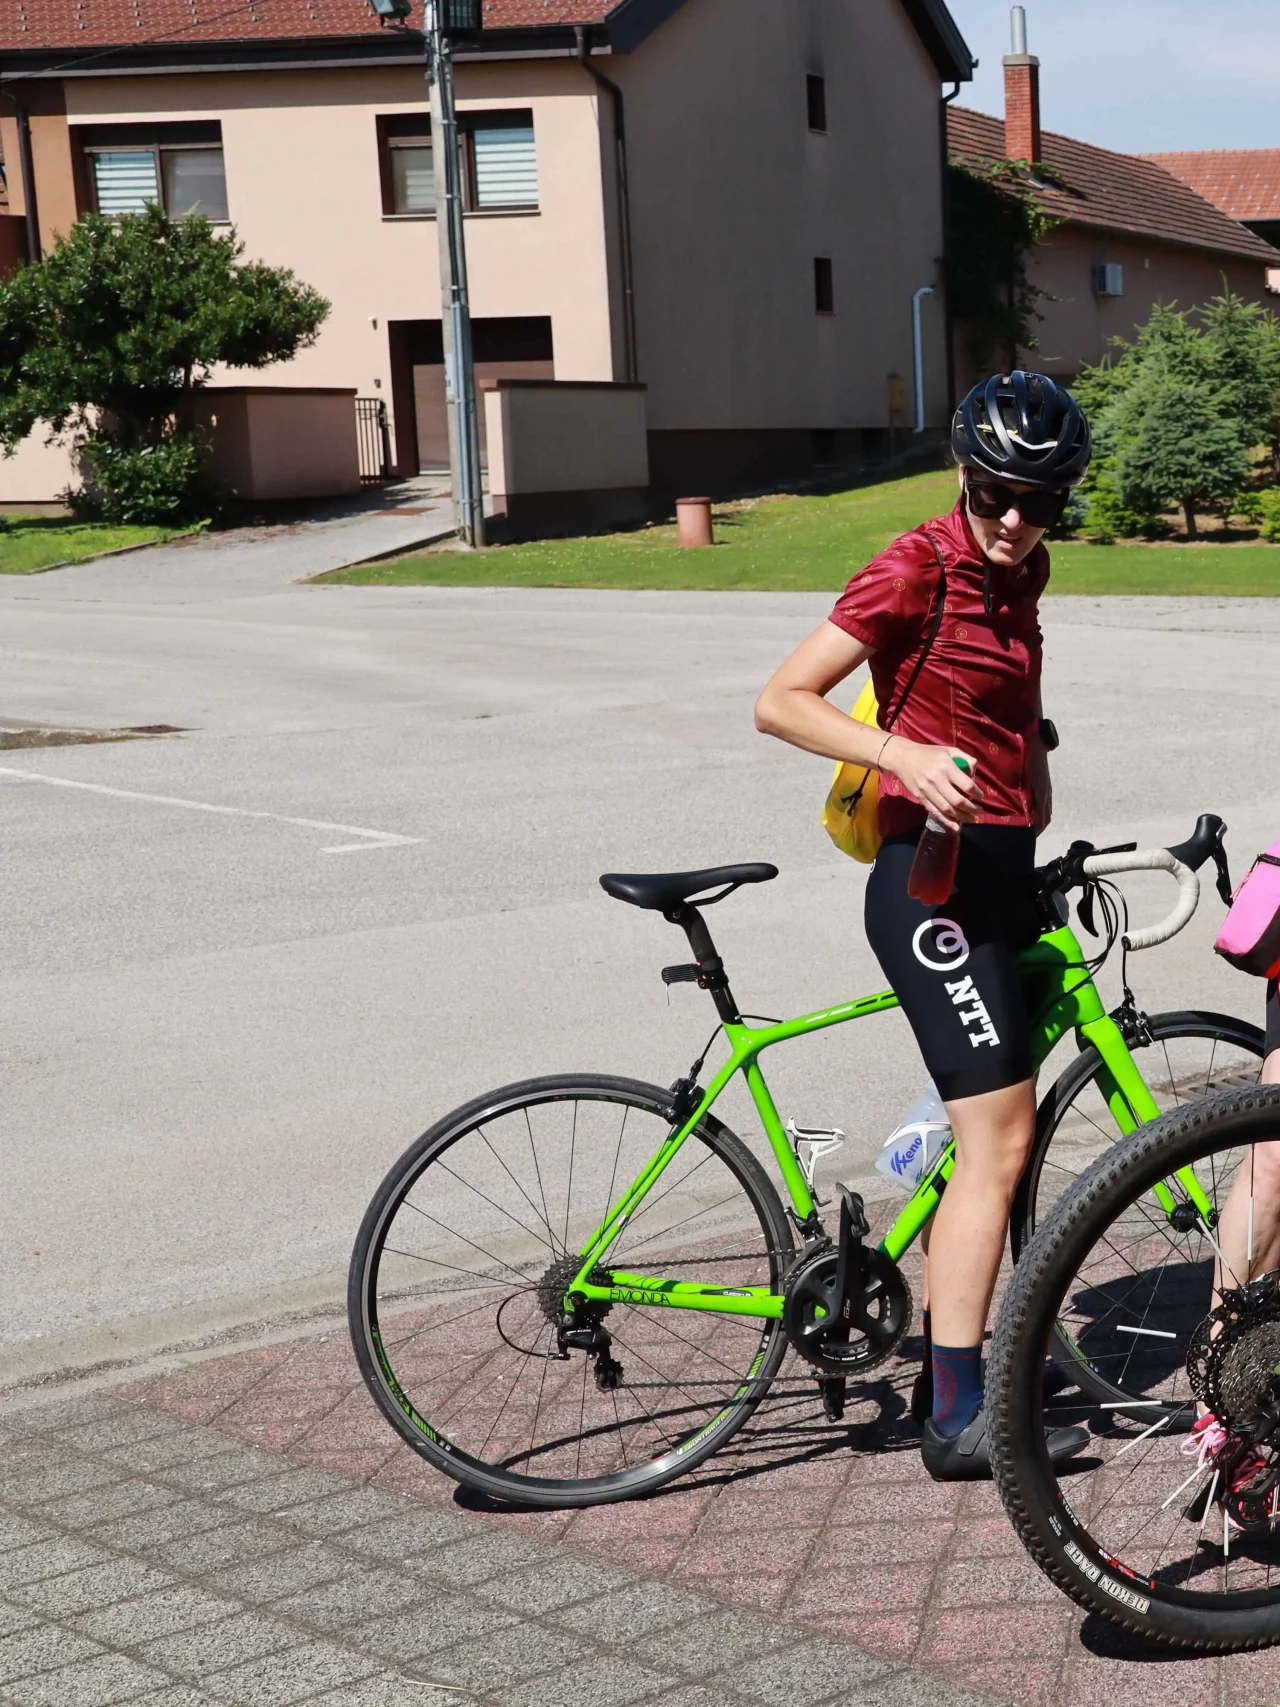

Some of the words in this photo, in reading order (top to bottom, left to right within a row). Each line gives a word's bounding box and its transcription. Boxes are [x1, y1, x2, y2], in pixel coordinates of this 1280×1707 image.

[943, 975, 1001, 1049] NTT
[609, 1288, 671, 1305] EMONDA
[1063, 1540, 1102, 1583] RACE
[1097, 1574, 1151, 1615] REKON
